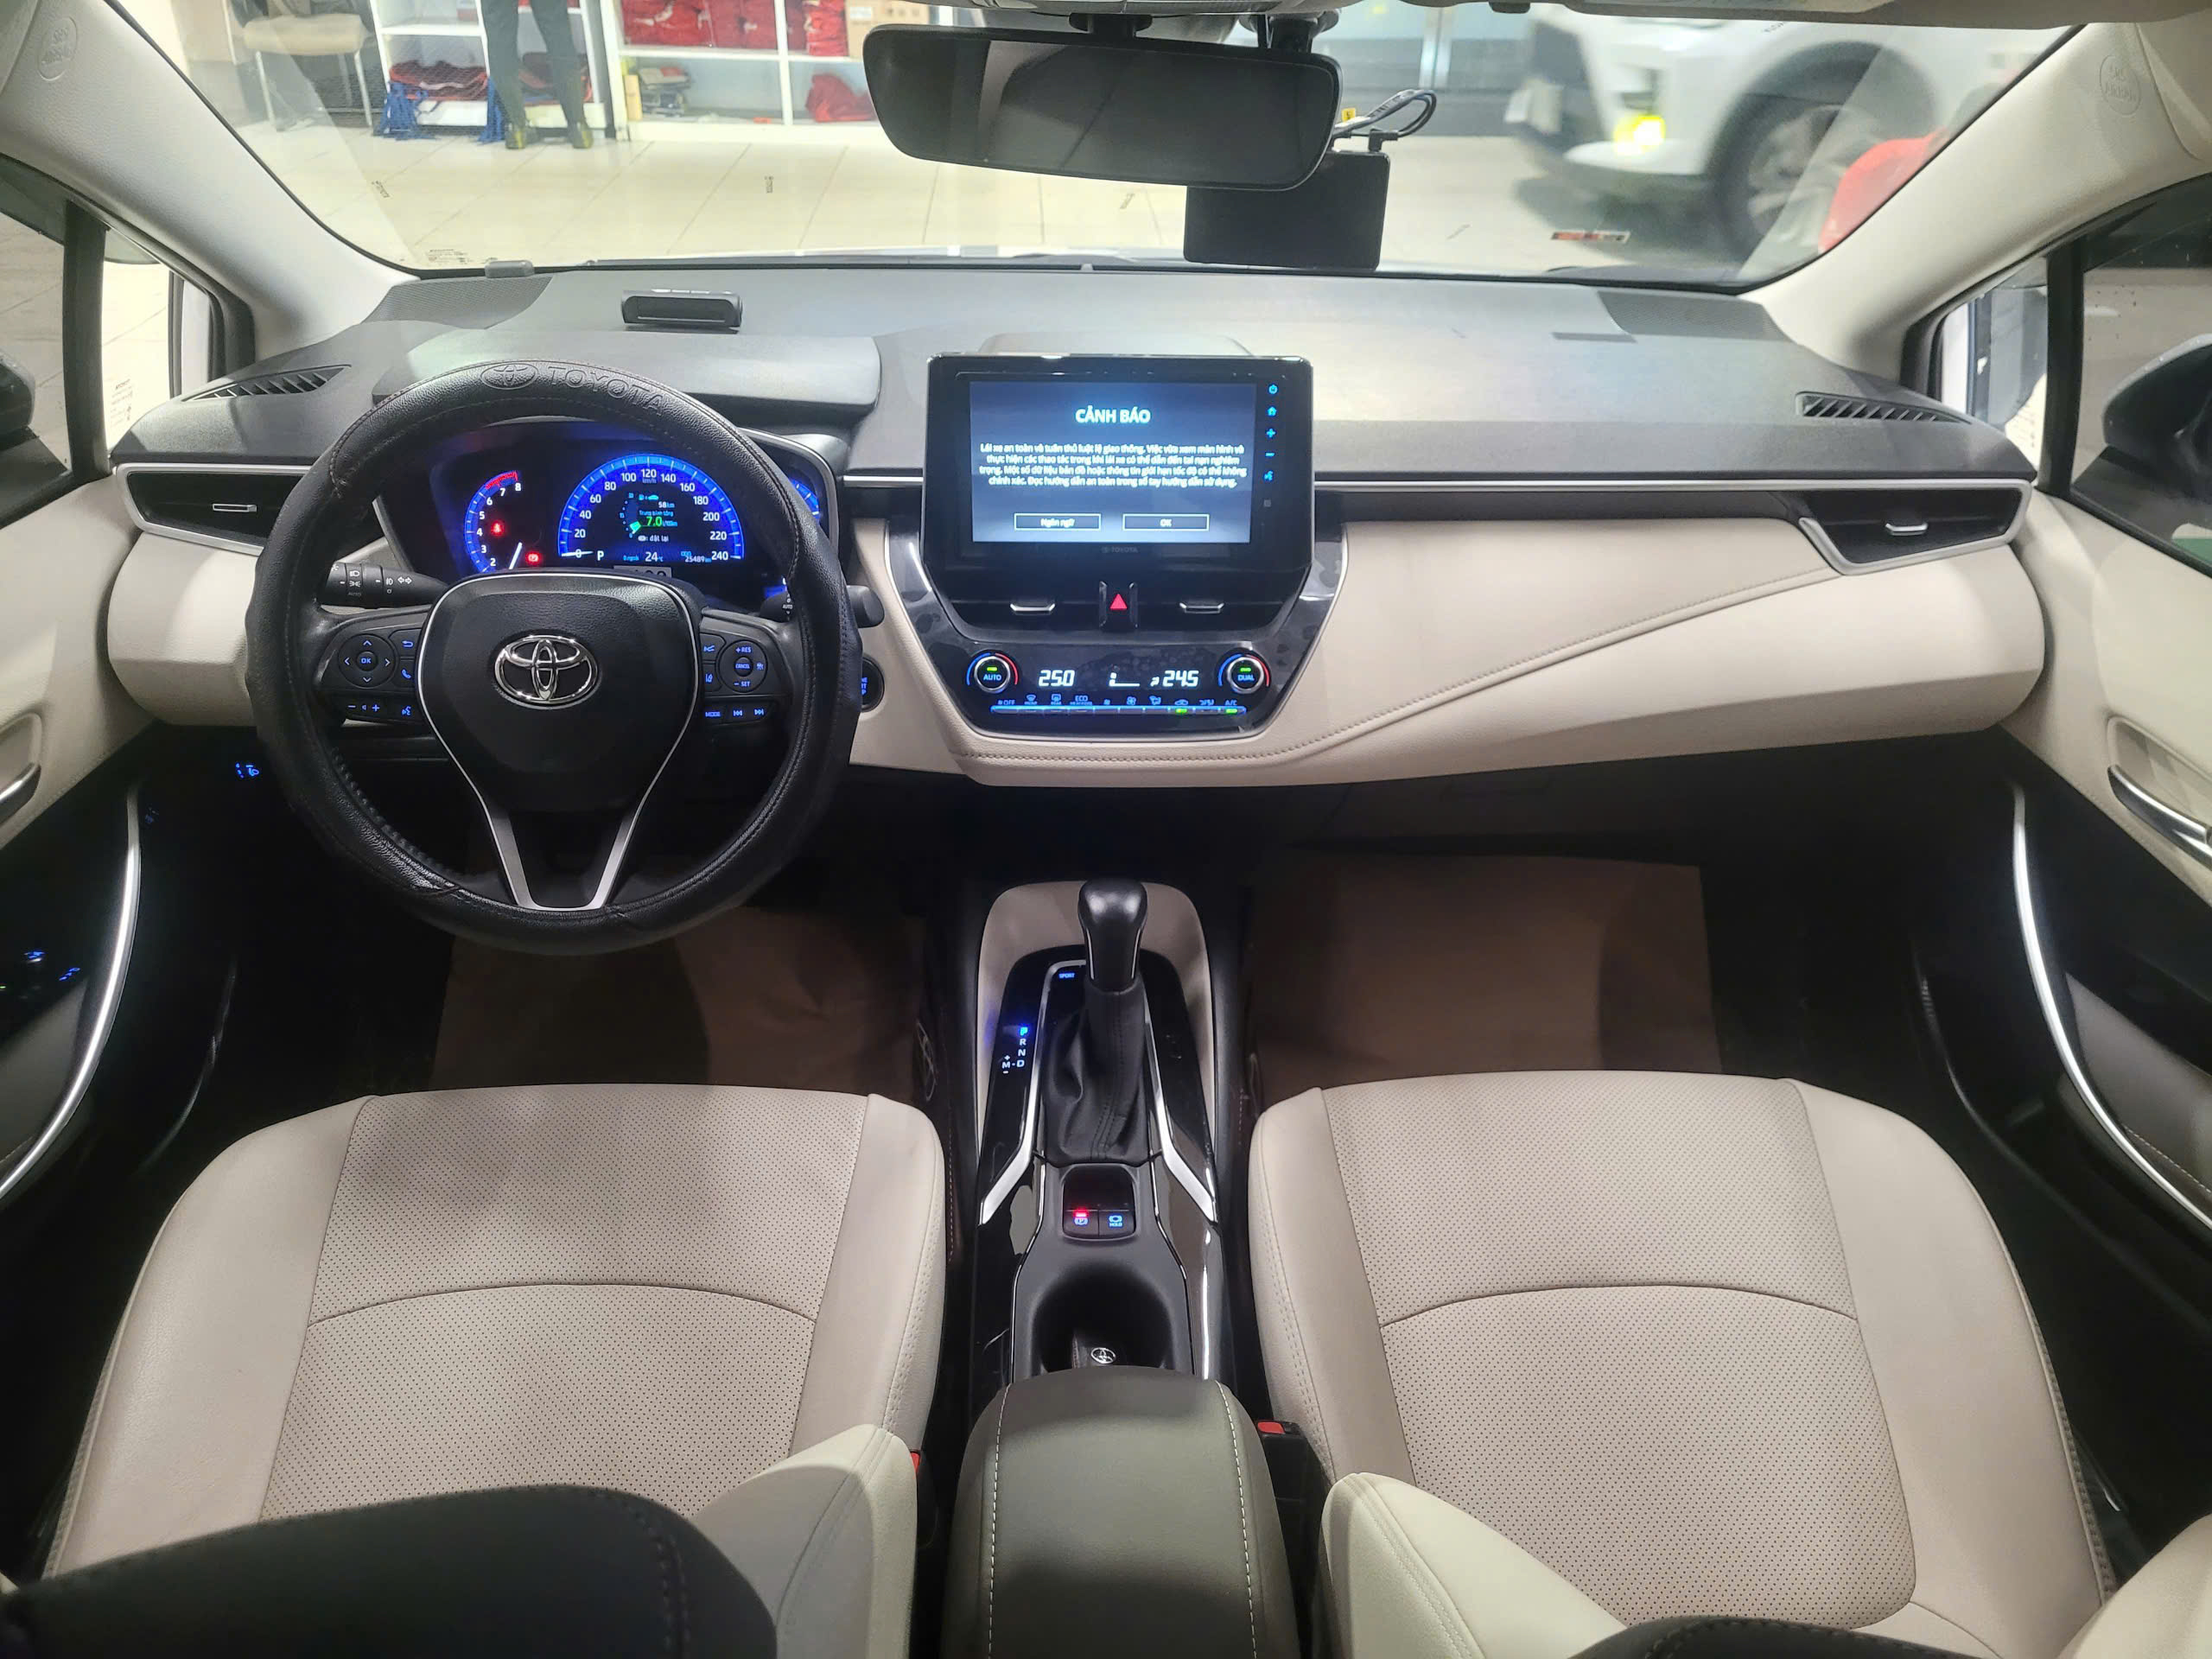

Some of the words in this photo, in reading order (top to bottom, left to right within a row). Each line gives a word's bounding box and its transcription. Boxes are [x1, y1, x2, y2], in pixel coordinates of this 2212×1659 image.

[548, 366, 664, 416] TOYOTA
[1075, 404, 1117, 423] CẢNH
[1119, 406, 1151, 423] BÁO
[621, 473, 637, 482] 100
[641, 468, 657, 478] 120
[660, 474, 676, 483] 140
[514, 482, 522, 492] 8
[604, 481, 616, 491] 80
[679, 482, 696, 493] 160
[499, 487, 506, 497] 7
[486, 497, 493, 505] 6
[589, 493, 601, 503] 60
[693, 495, 709, 505] 180
[479, 511, 486, 519] 5
[579, 510, 592, 519] 40
[702, 512, 721, 521] 200
[646, 516, 663, 526] 7.0
[1160, 518, 1173, 527] OK
[476, 527, 483, 537] 4
[574, 529, 586, 538] 20
[709, 531, 727, 540] 220
[480, 544, 487, 554] 3
[597, 550, 604, 561] P
[645, 551, 658, 563] 24
[711, 551, 728, 561] 240
[490, 557, 497, 567] 2
[1020, 1027, 1029, 1037] P
[1020, 1038, 1027, 1046] R
[1018, 1048, 1027, 1057] N
[1016, 1058, 1025, 1068] D
